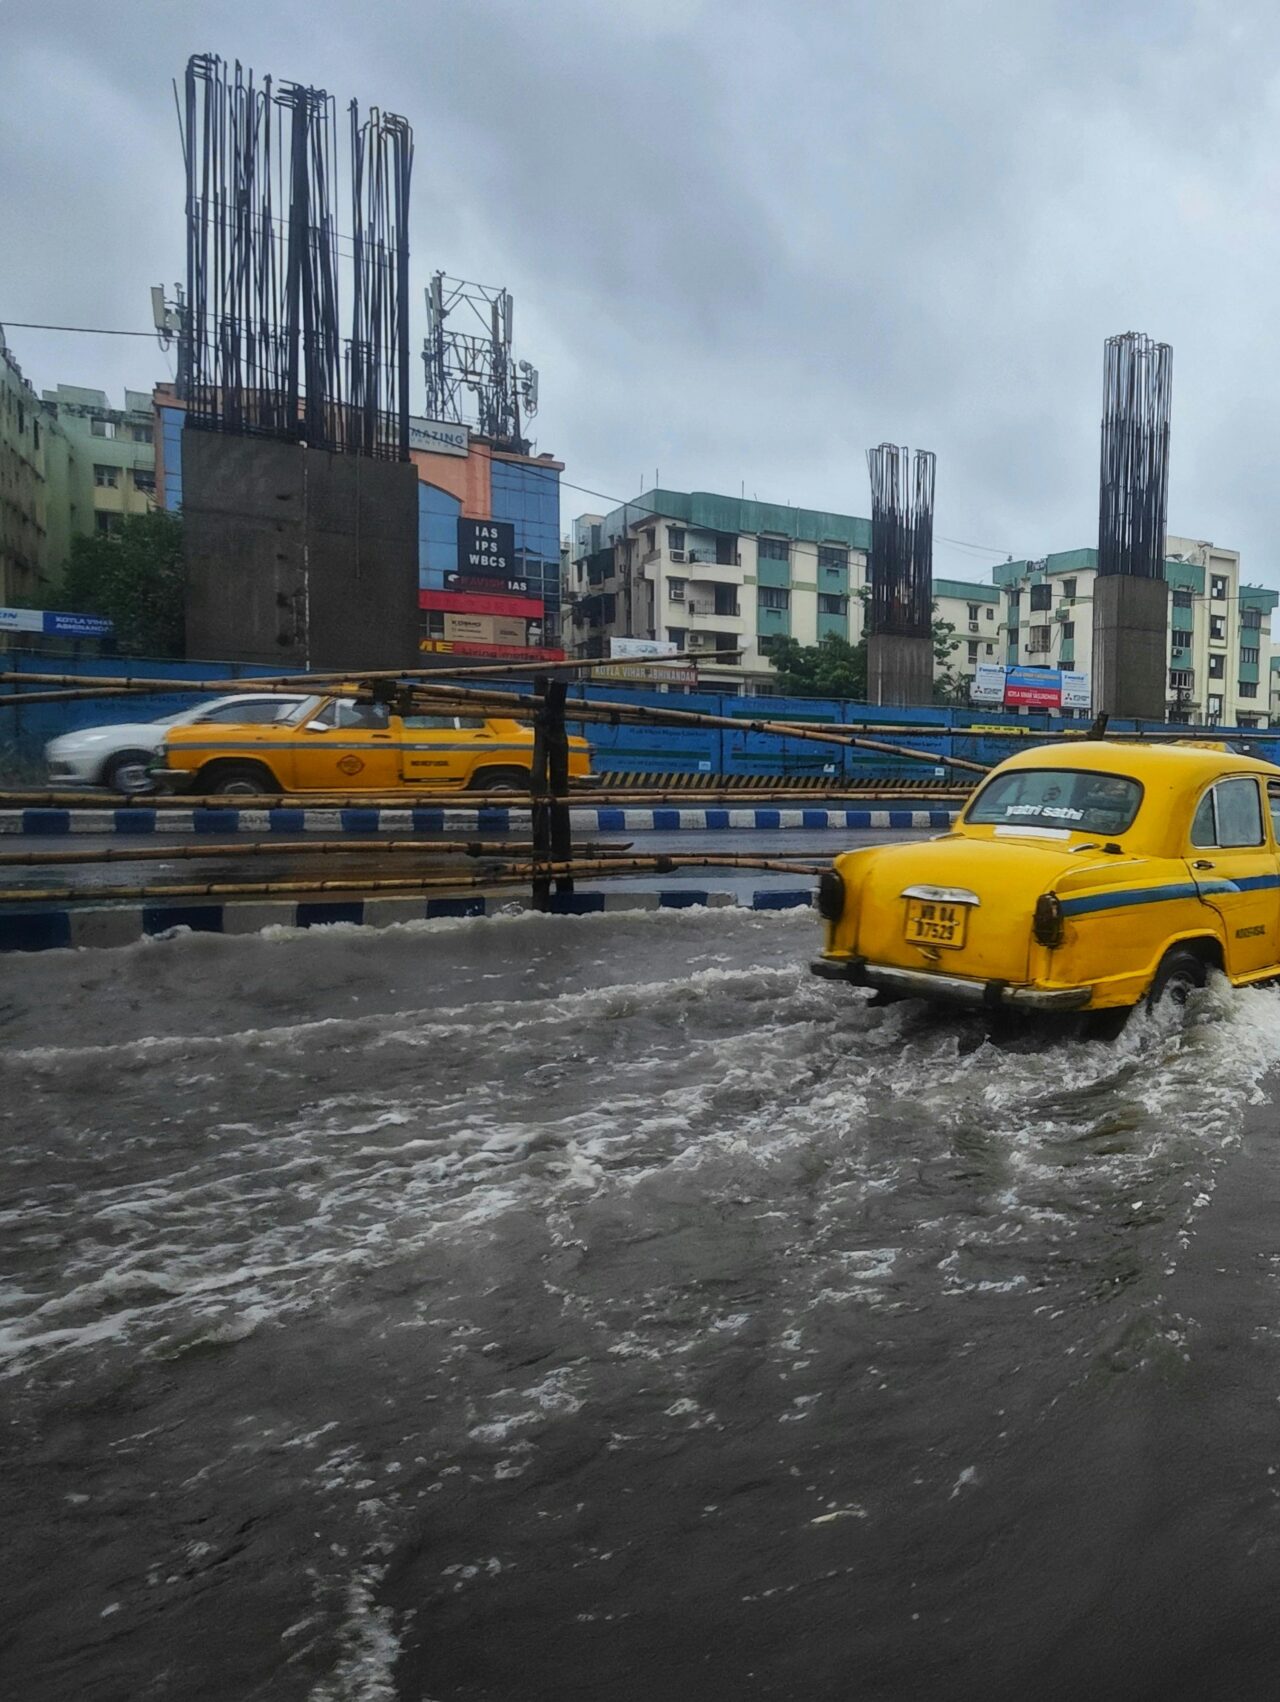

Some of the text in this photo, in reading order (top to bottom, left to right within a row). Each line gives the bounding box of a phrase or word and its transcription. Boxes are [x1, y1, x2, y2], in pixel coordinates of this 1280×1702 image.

[475, 526, 498, 538] IAS
[475, 540, 498, 552] IPS
[469, 554, 506, 567] WBCS
[508, 581, 527, 591] IAS
[623, 667, 646, 678] VIHAR
[1005, 805, 1084, 820] yatri sathi
